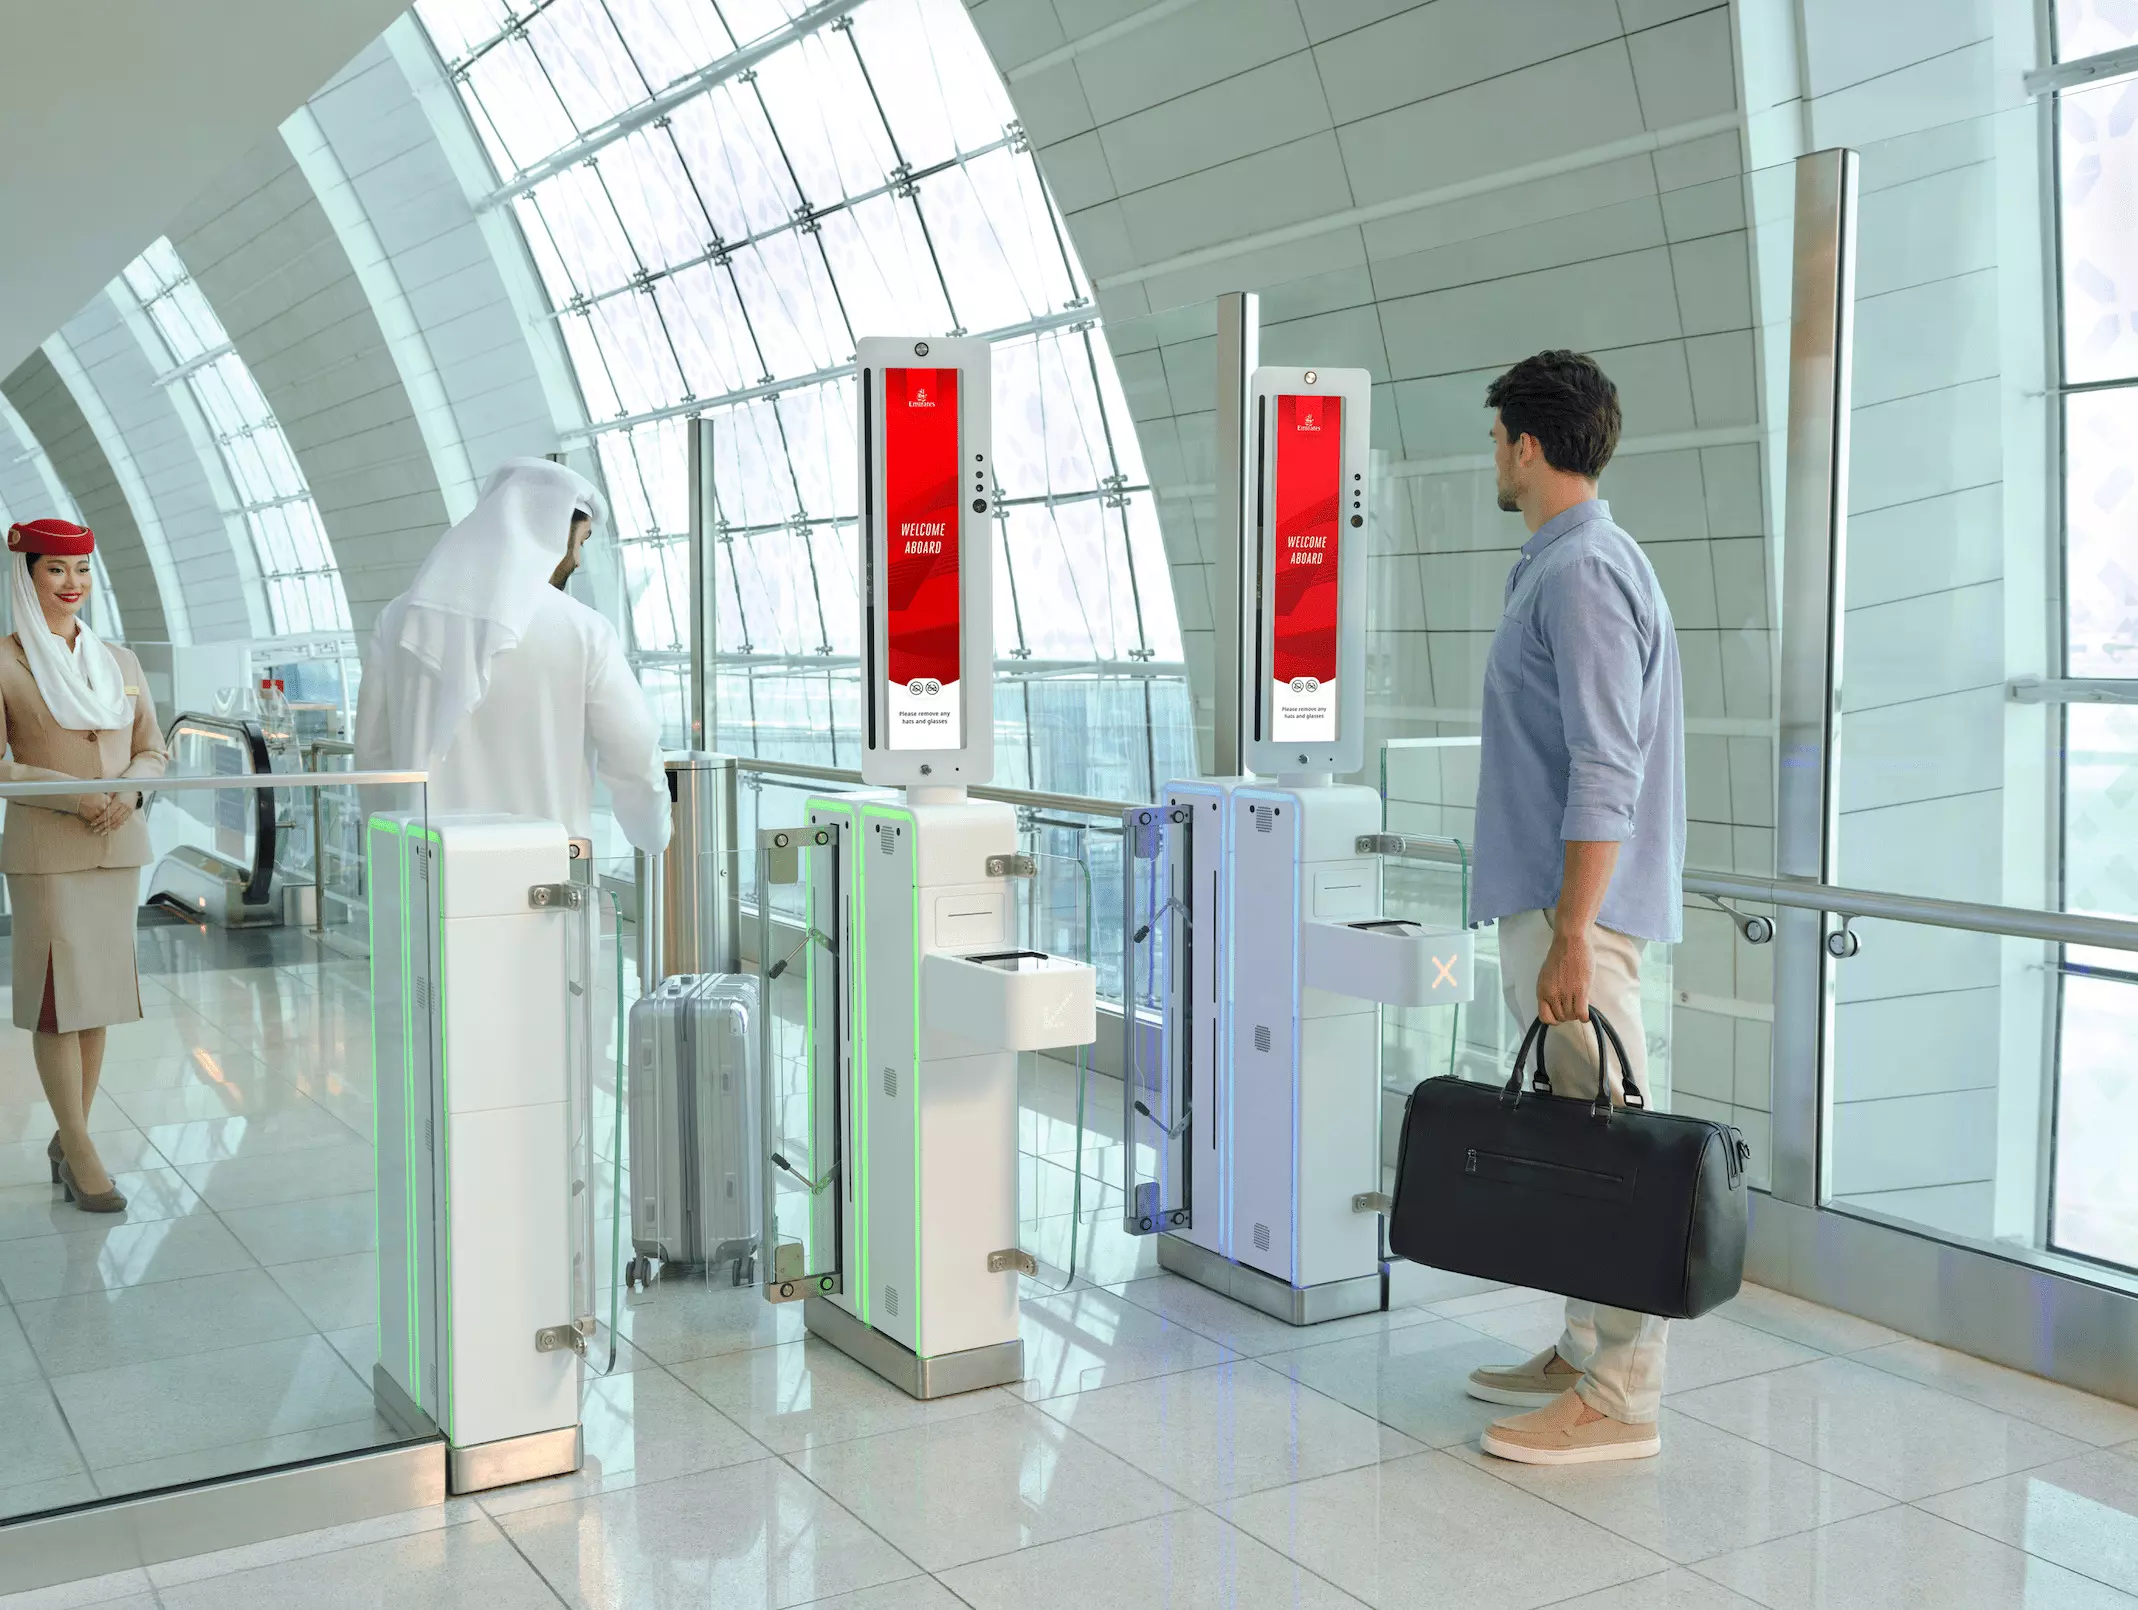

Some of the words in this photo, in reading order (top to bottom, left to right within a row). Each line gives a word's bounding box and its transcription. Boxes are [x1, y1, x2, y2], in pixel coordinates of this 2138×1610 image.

[901, 523, 945, 536] WELCOME
[905, 541, 941, 554] ABOARD
[1287, 536, 1327, 548] WELCOME
[1290, 553, 1323, 564] ABOARD
